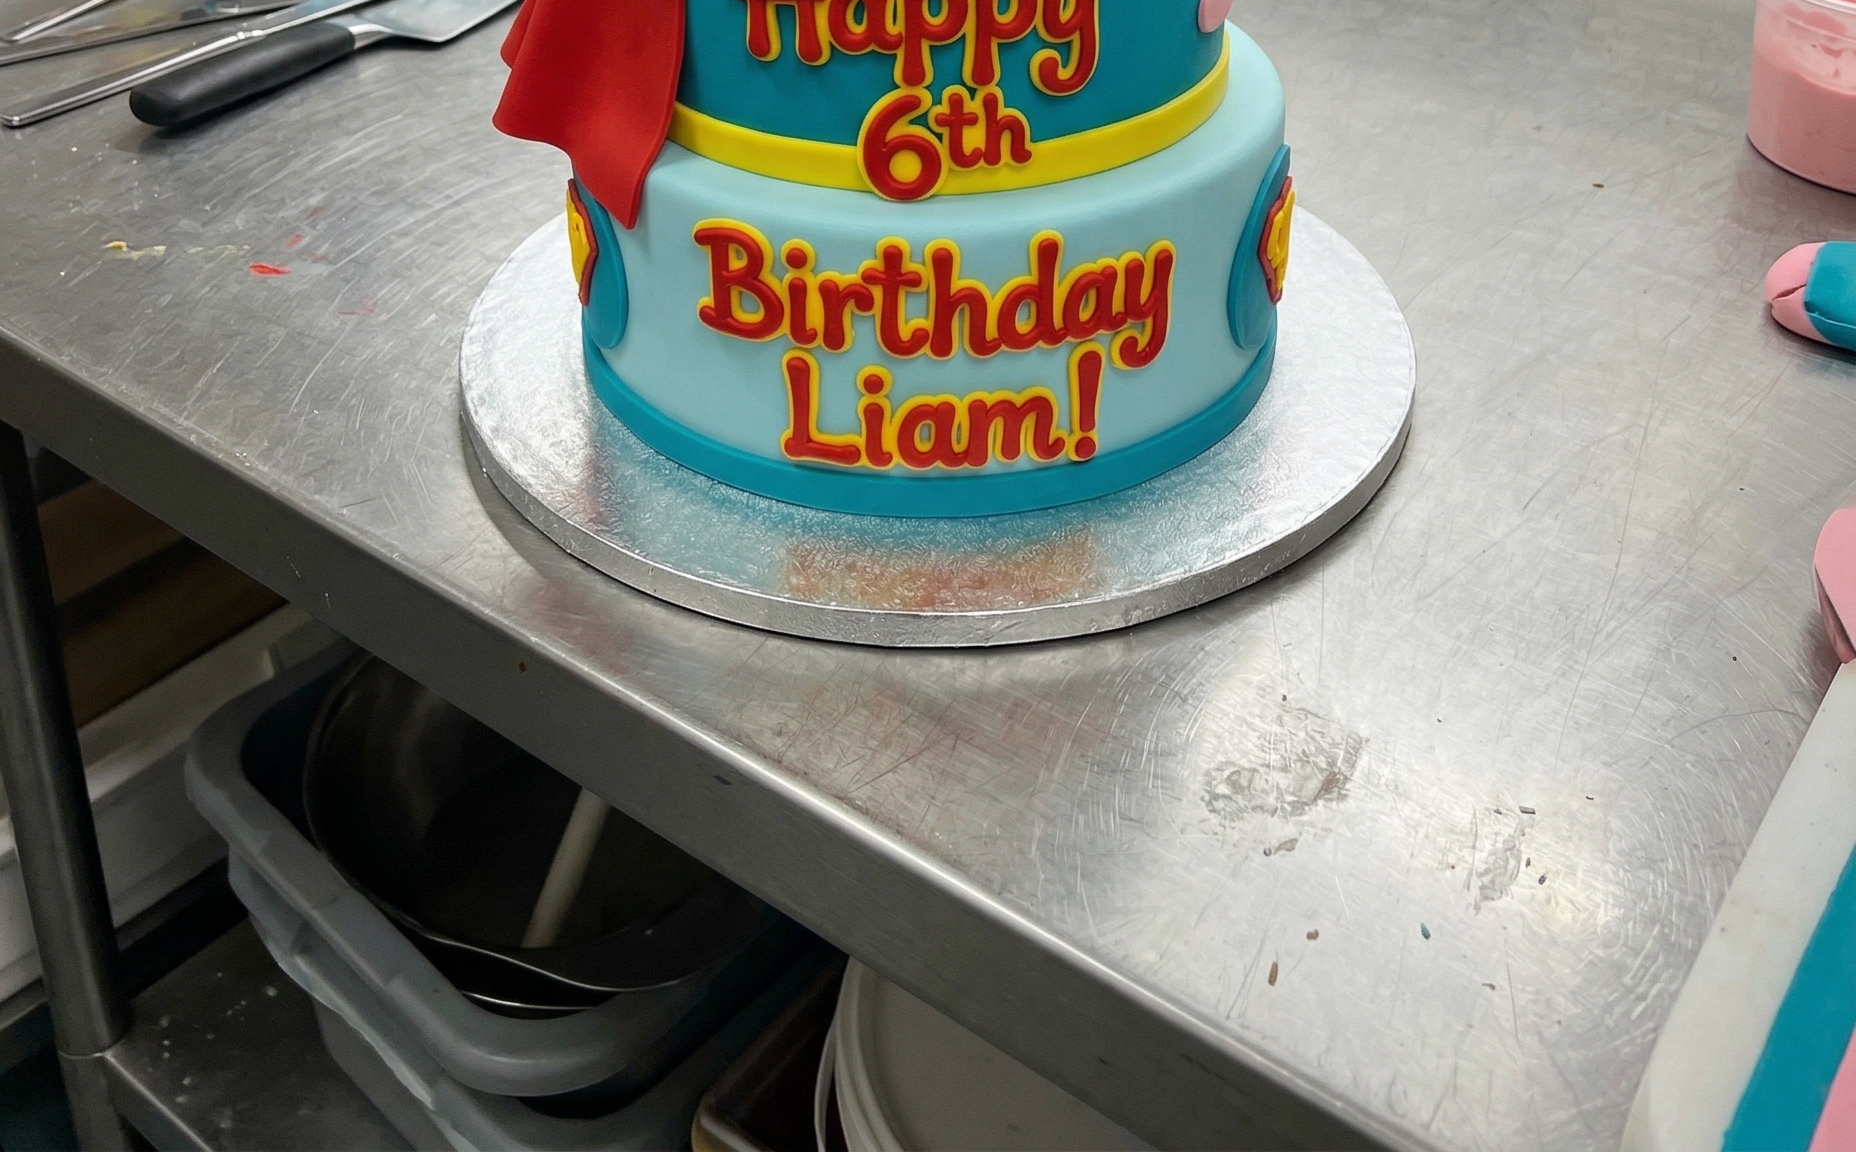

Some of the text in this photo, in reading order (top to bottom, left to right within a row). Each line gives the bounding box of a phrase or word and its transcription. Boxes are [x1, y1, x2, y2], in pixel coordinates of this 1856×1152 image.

[858, 84, 1033, 202] 6th
[693, 218, 1175, 369] Birthday
[782, 342, 1105, 469] Liam!
